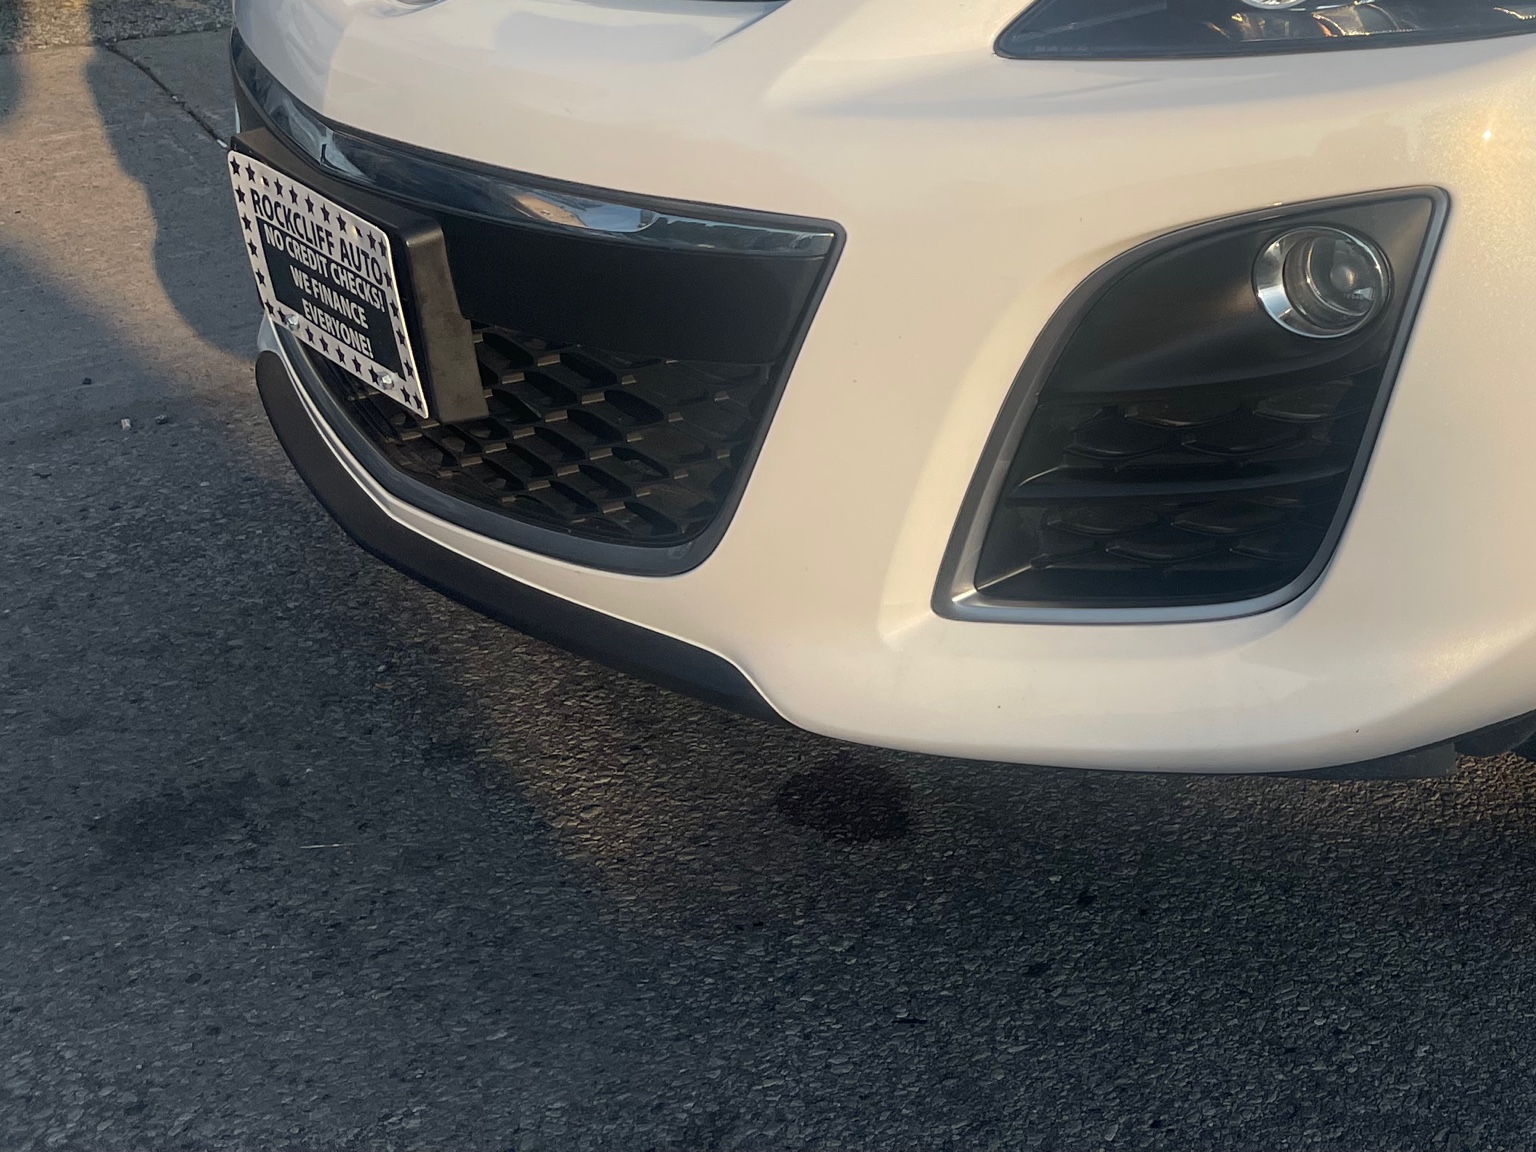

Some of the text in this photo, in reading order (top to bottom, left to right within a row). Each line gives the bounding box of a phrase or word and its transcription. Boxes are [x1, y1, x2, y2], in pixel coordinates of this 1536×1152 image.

[250, 187, 384, 286] ROCKCLIFF AUTO
[263, 222, 386, 313] NO CREDIT CHECKS!
[289, 263, 369, 330] WE FINANCE
[300, 297, 375, 360] EVERYONE!
